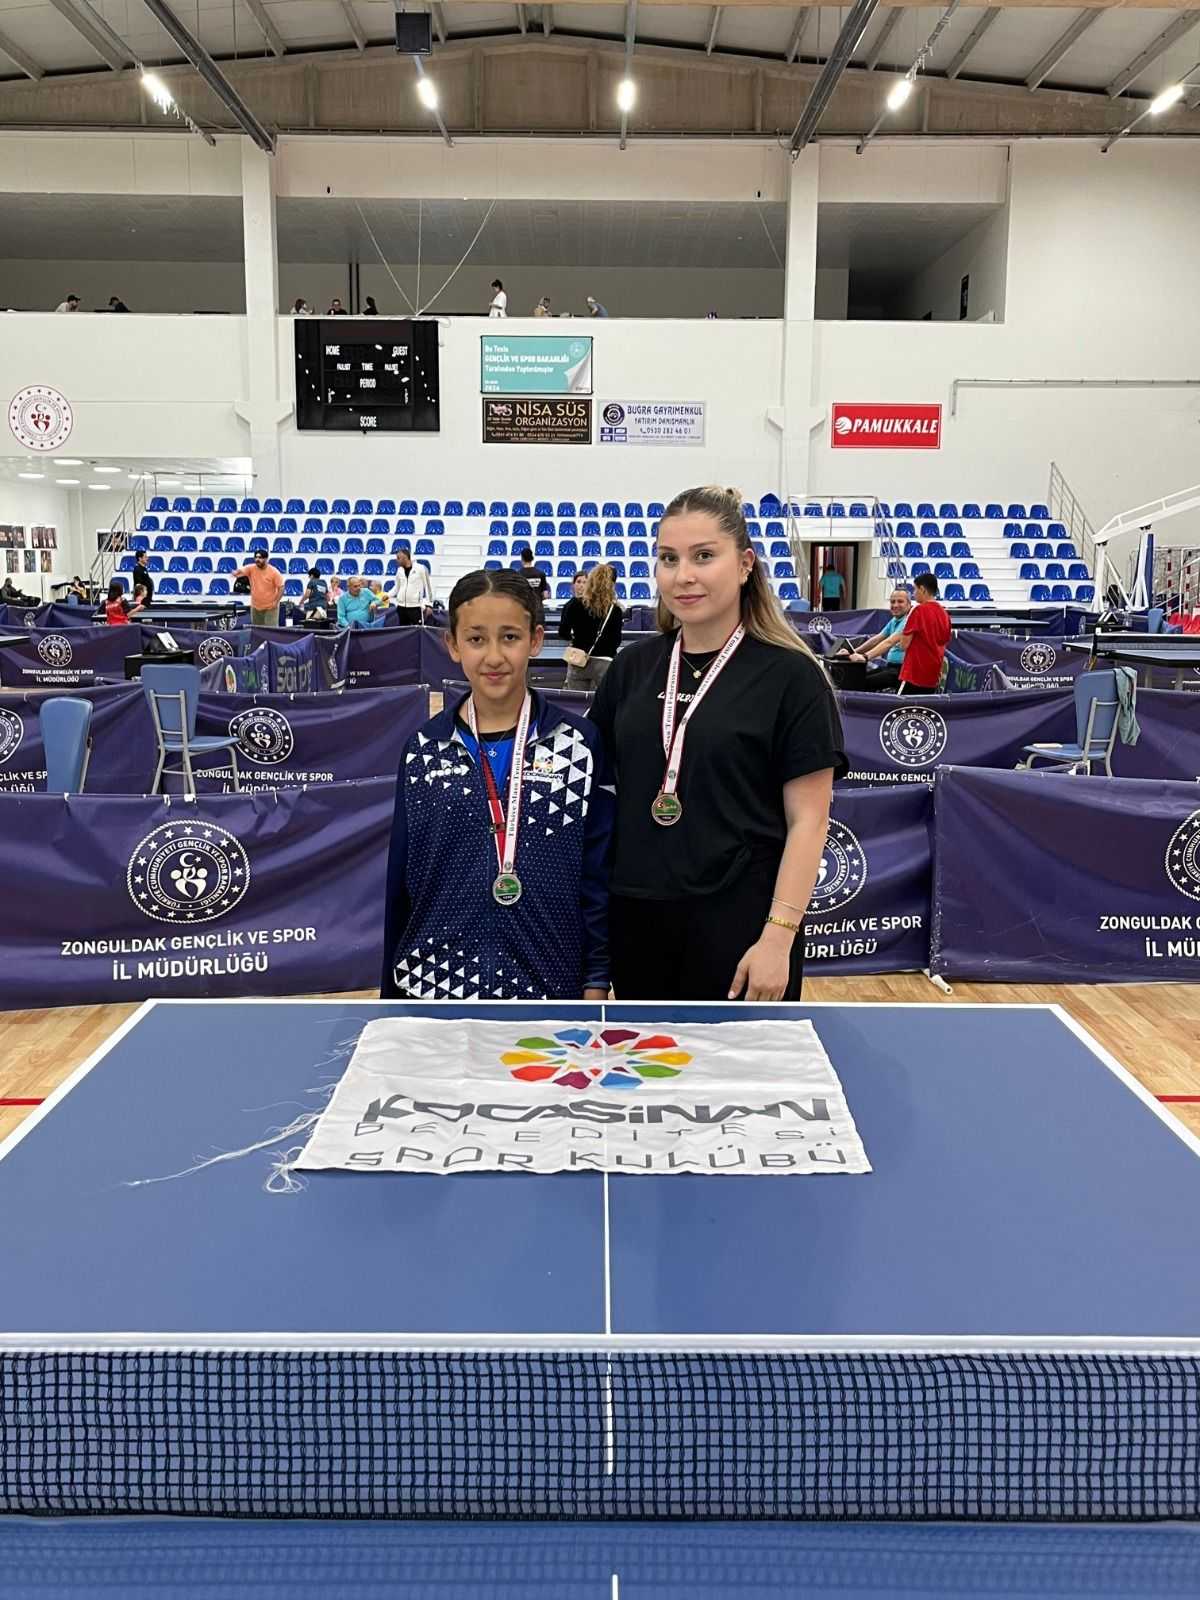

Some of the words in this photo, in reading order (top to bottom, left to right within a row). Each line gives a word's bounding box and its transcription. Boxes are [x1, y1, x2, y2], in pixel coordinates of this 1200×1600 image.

[392, 346, 408, 357] GUEST
[361, 362, 374, 371] TIME
[360, 378, 376, 388] PERIOD
[516, 401, 552, 416] NİSA
[556, 401, 586, 416] SÜS
[360, 416, 377, 427] SCORE
[515, 416, 588, 427] ORGANİZASYON
[852, 418, 938, 434] PAMUKKALE
[21, 771, 34, 780] VE
[36, 770, 48, 780] SP
[197, 769, 253, 780] ZONGULAK
[254, 770, 295, 781] GENÇLİK
[296, 773, 308, 781] VE
[309, 773, 334, 782] SPOR
[843, 771, 899, 782] ONGULDAK
[177, 840, 212, 853] GENÇLİK
[804, 918, 856, 936] ENÇLİK
[860, 918, 878, 931] VE
[881, 915, 922, 930] SPOR
[1100, 916, 1192, 930] ZONGULDAK
[61, 937, 167, 956] ZONGULDAK
[171, 929, 244, 951] GENÇLİK
[248, 930, 269, 945] VE
[272, 927, 317, 944] SPOR
[1145, 937, 1164, 957] İL
[804, 939, 877, 959] ÜRLÜĞÜ
[112, 959, 132, 981] İL
[137, 951, 269, 980] MÜDÜRLÜĞÜ
[344, 1146, 535, 1169] SPOR
[570, 1142, 847, 1169] KULÜBÜ
